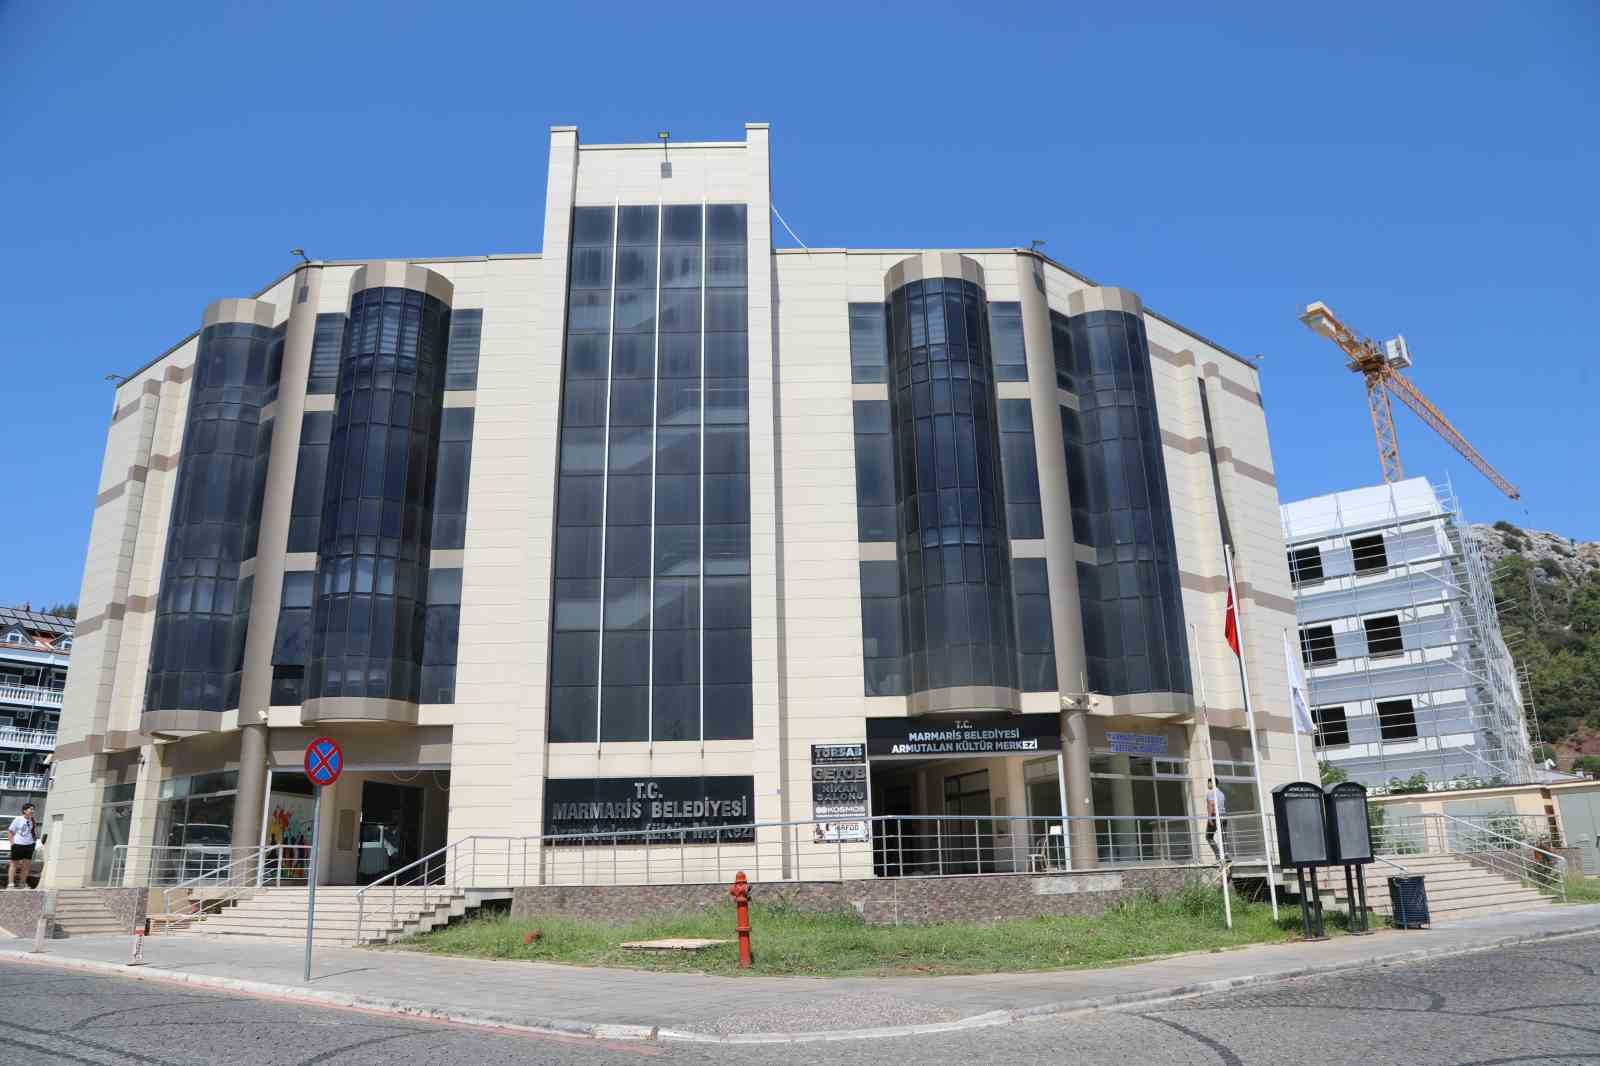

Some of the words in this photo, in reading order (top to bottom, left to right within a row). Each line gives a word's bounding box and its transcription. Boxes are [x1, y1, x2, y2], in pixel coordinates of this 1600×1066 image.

[955, 720, 973, 729] T.C.
[908, 730, 961, 741] MARMARİS
[964, 728, 1020, 739] BELEDİYESİ
[891, 742, 953, 754] ARMUTALAN
[955, 740, 993, 751] KÜLTÜR
[995, 739, 1038, 750] MERKEZİ
[634, 782, 664, 799] T.C.
[816, 792, 864, 801] SALONU
[551, 798, 643, 819] MARMARİS
[651, 796, 748, 818] BELEDİYESİ
